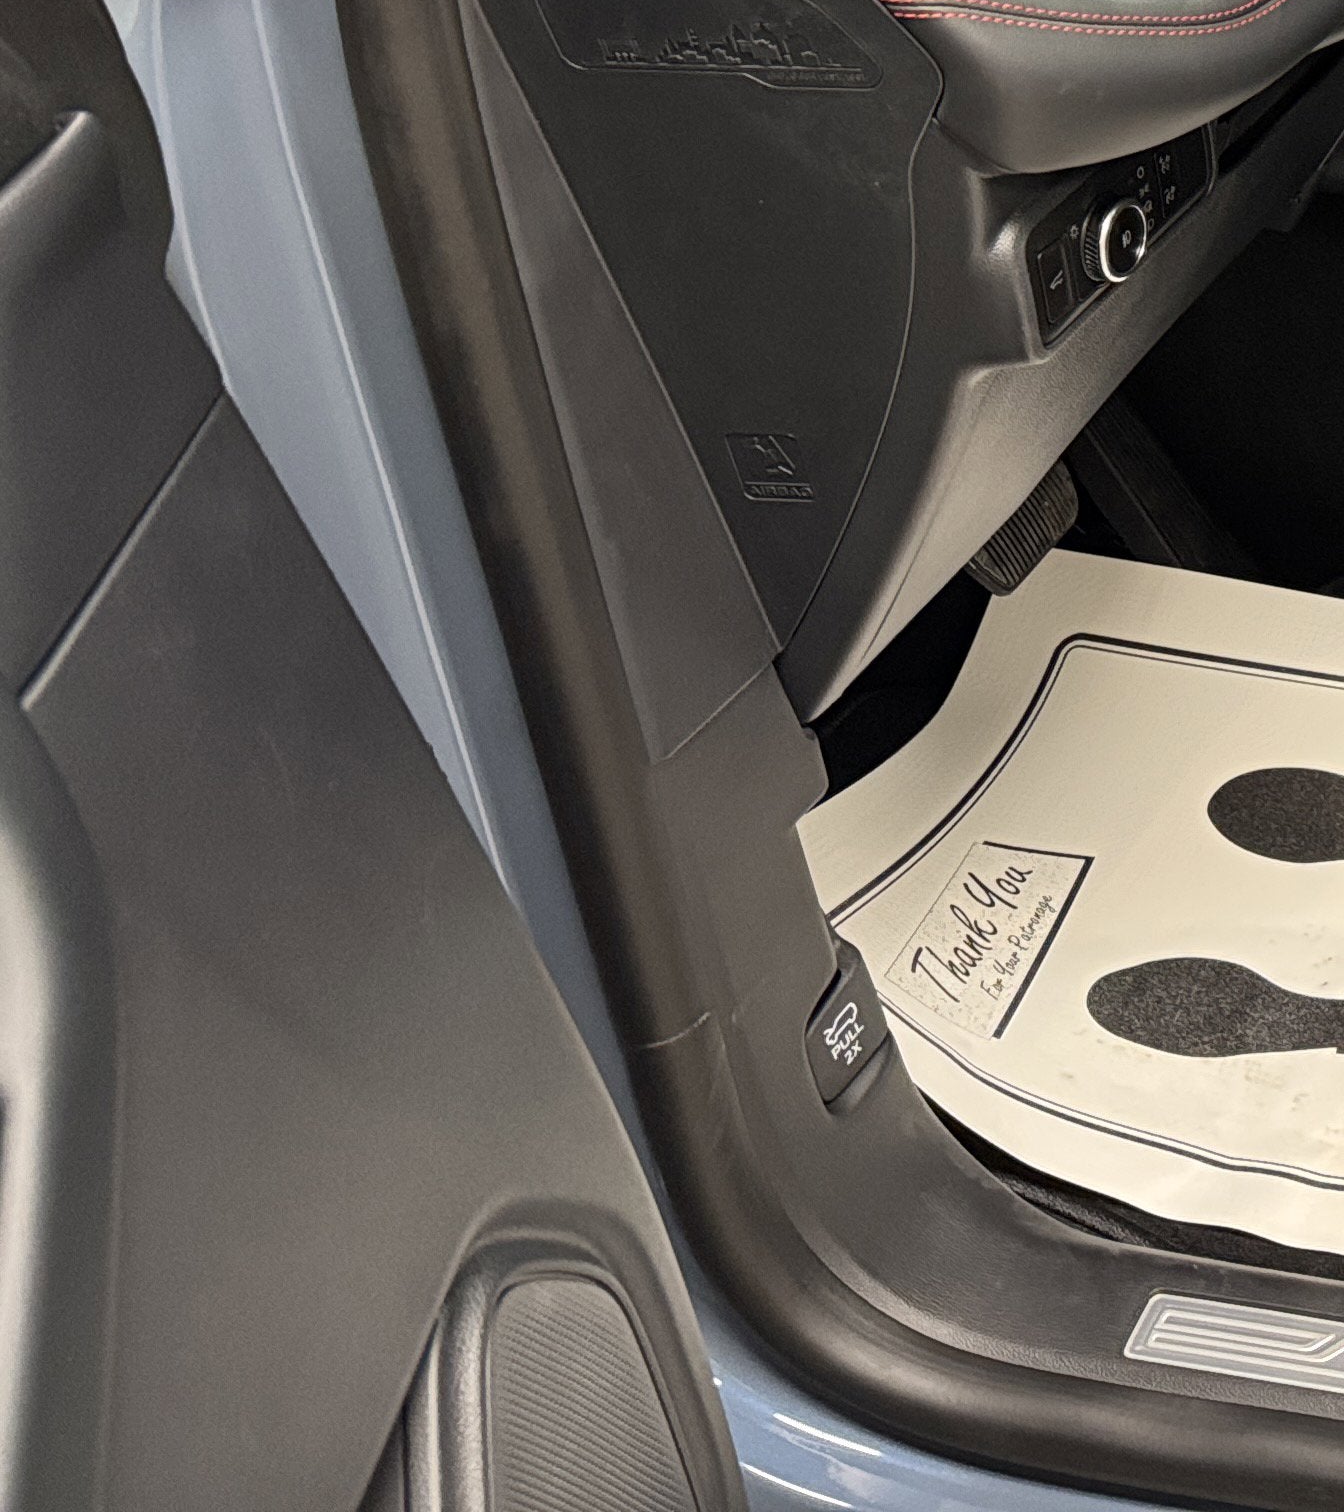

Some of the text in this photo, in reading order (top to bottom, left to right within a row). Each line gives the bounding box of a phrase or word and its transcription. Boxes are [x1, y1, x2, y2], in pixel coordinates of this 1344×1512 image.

[911, 866, 1033, 1003] Thank You
[980, 894, 1058, 1001] For Your Patronage
[831, 1022, 865, 1061] PULL
[844, 1039, 863, 1066] 2X
